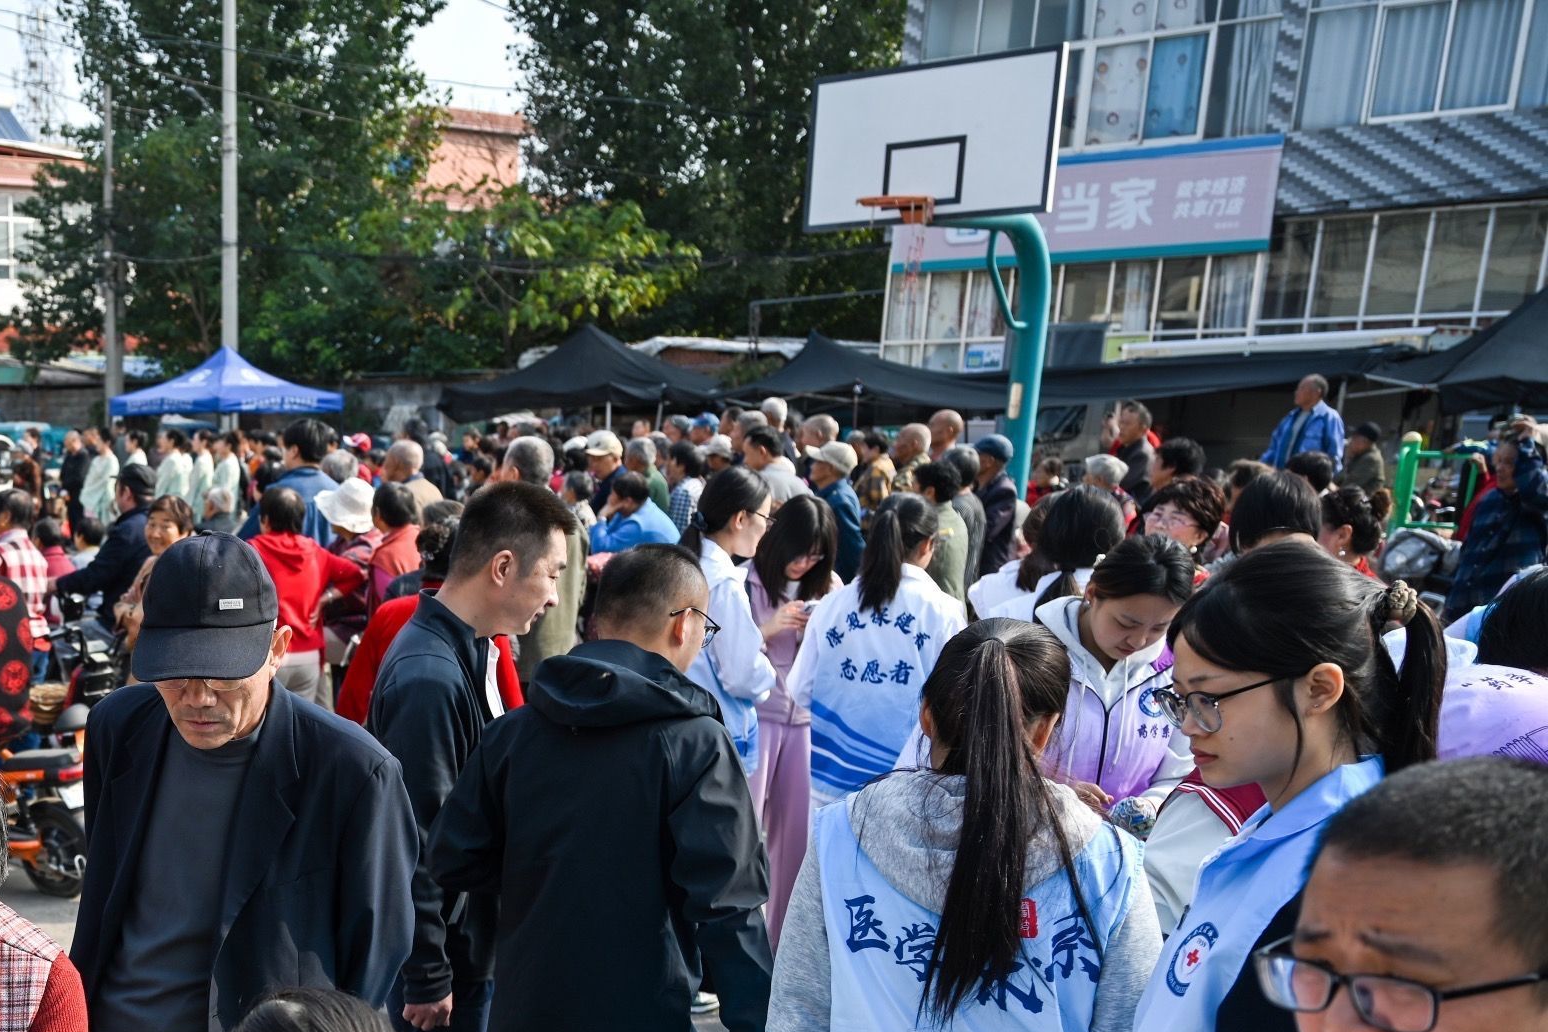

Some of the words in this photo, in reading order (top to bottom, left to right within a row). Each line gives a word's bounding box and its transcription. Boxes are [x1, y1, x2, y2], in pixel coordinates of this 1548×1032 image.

[1039, 178, 1156, 236] 当家
[840, 657, 915, 685] 志愿者
[1137, 723, 1170, 739] 药学系
[844, 894, 1102, 1014] 医学术系
